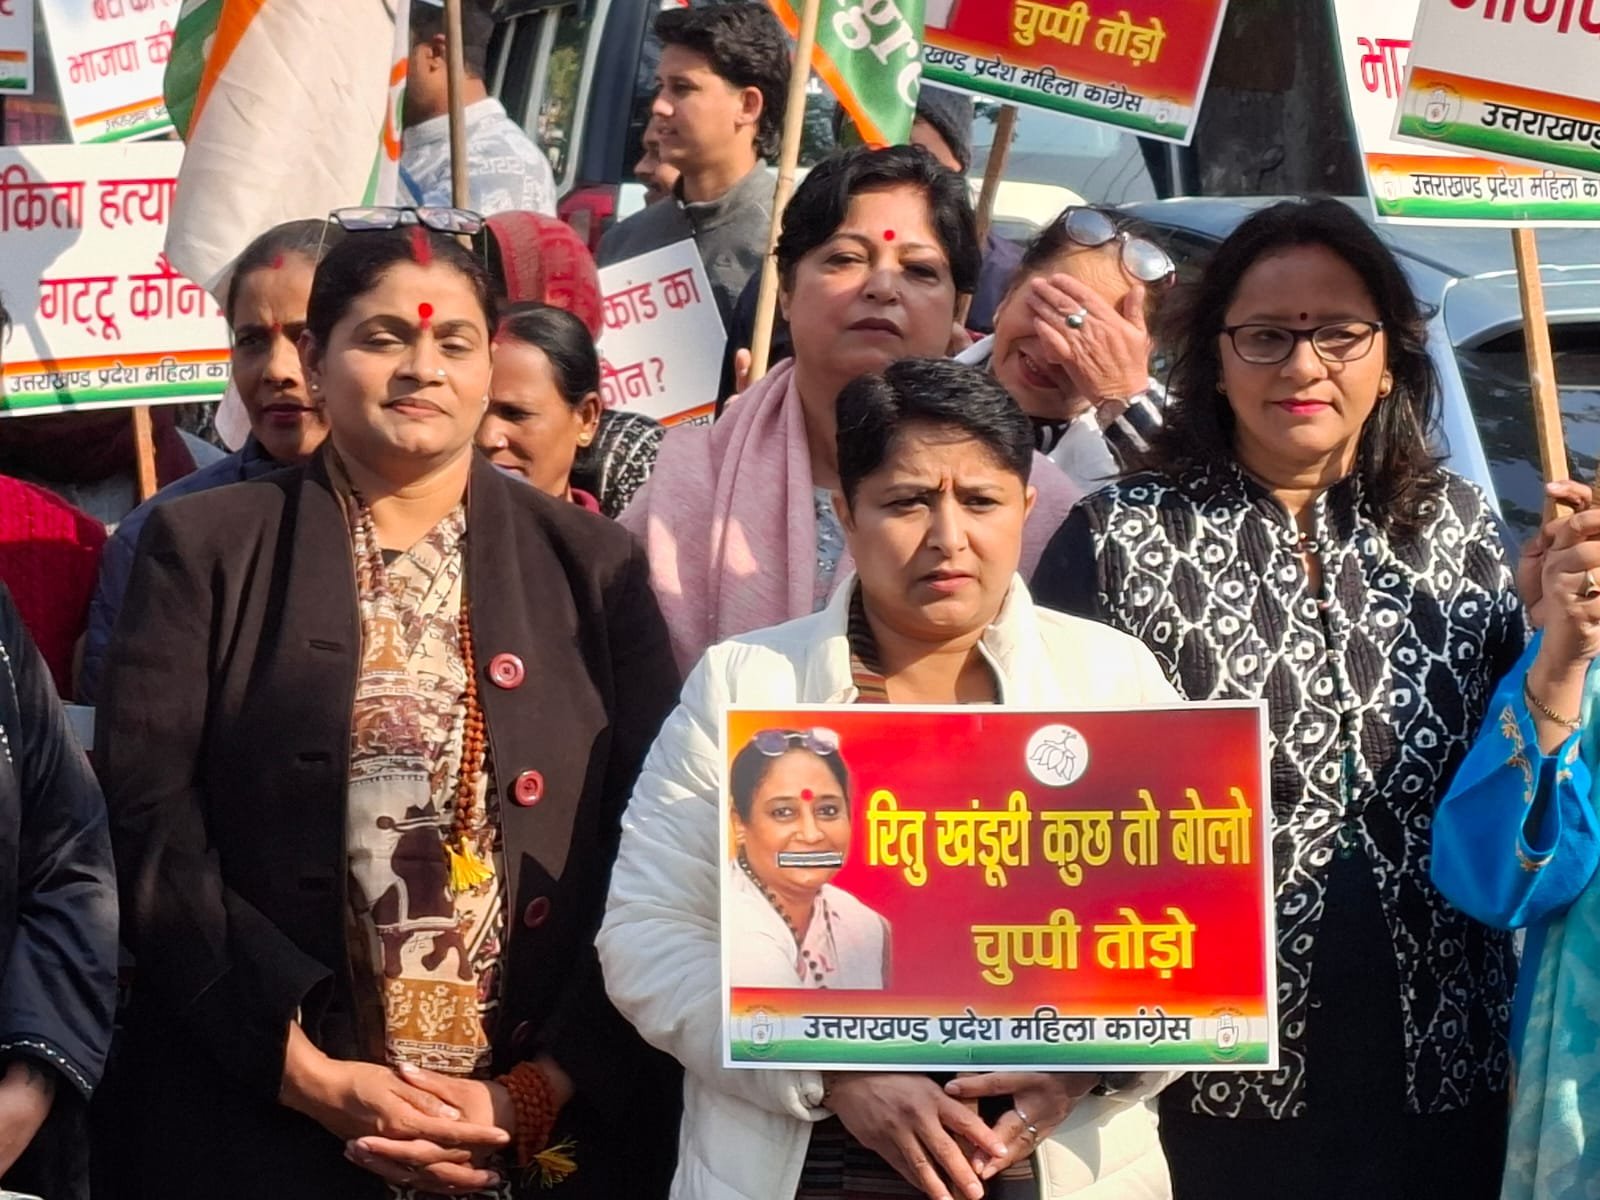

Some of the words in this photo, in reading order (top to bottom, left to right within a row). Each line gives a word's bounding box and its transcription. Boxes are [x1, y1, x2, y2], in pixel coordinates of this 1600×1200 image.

[67, 40, 140, 83] भाजपा
[1013, 0, 1090, 46] चुप्पी
[1094, 10, 1166, 67] तोड़ो
[923, 46, 969, 72] खण्ड
[974, 56, 1017, 82] प्रदेश
[1020, 67, 1079, 99] महिला
[1083, 82, 1144, 112] कांग्रेस
[1357, 37, 1414, 98] भा
[0, 164, 86, 231] किता
[1409, 174, 1483, 198] उत्तराखण्ड
[1486, 169, 1525, 201] प्रदेश
[1529, 169, 1578, 200] महिला
[658, 267, 702, 309] का
[10, 370, 92, 393] उत्तराखण्ड
[98, 362, 139, 388] प्रदेश
[145, 358, 200, 382] महिला
[866, 791, 926, 887] रितु
[935, 791, 1031, 888] खंडूरी
[1041, 811, 1113, 886] कुछ
[1121, 790, 1160, 867] तो
[1170, 788, 1252, 866] बोलो
[971, 909, 1082, 985] चुप्पी
[1094, 908, 1196, 980] तोड़ो
[802, 1016, 928, 1042] उत्तराखण्ड
[937, 1009, 1002, 1045] प्रदेश
[1010, 1009, 1096, 1043] महिला
[1105, 1010, 1191, 1045] कांग्रेस
